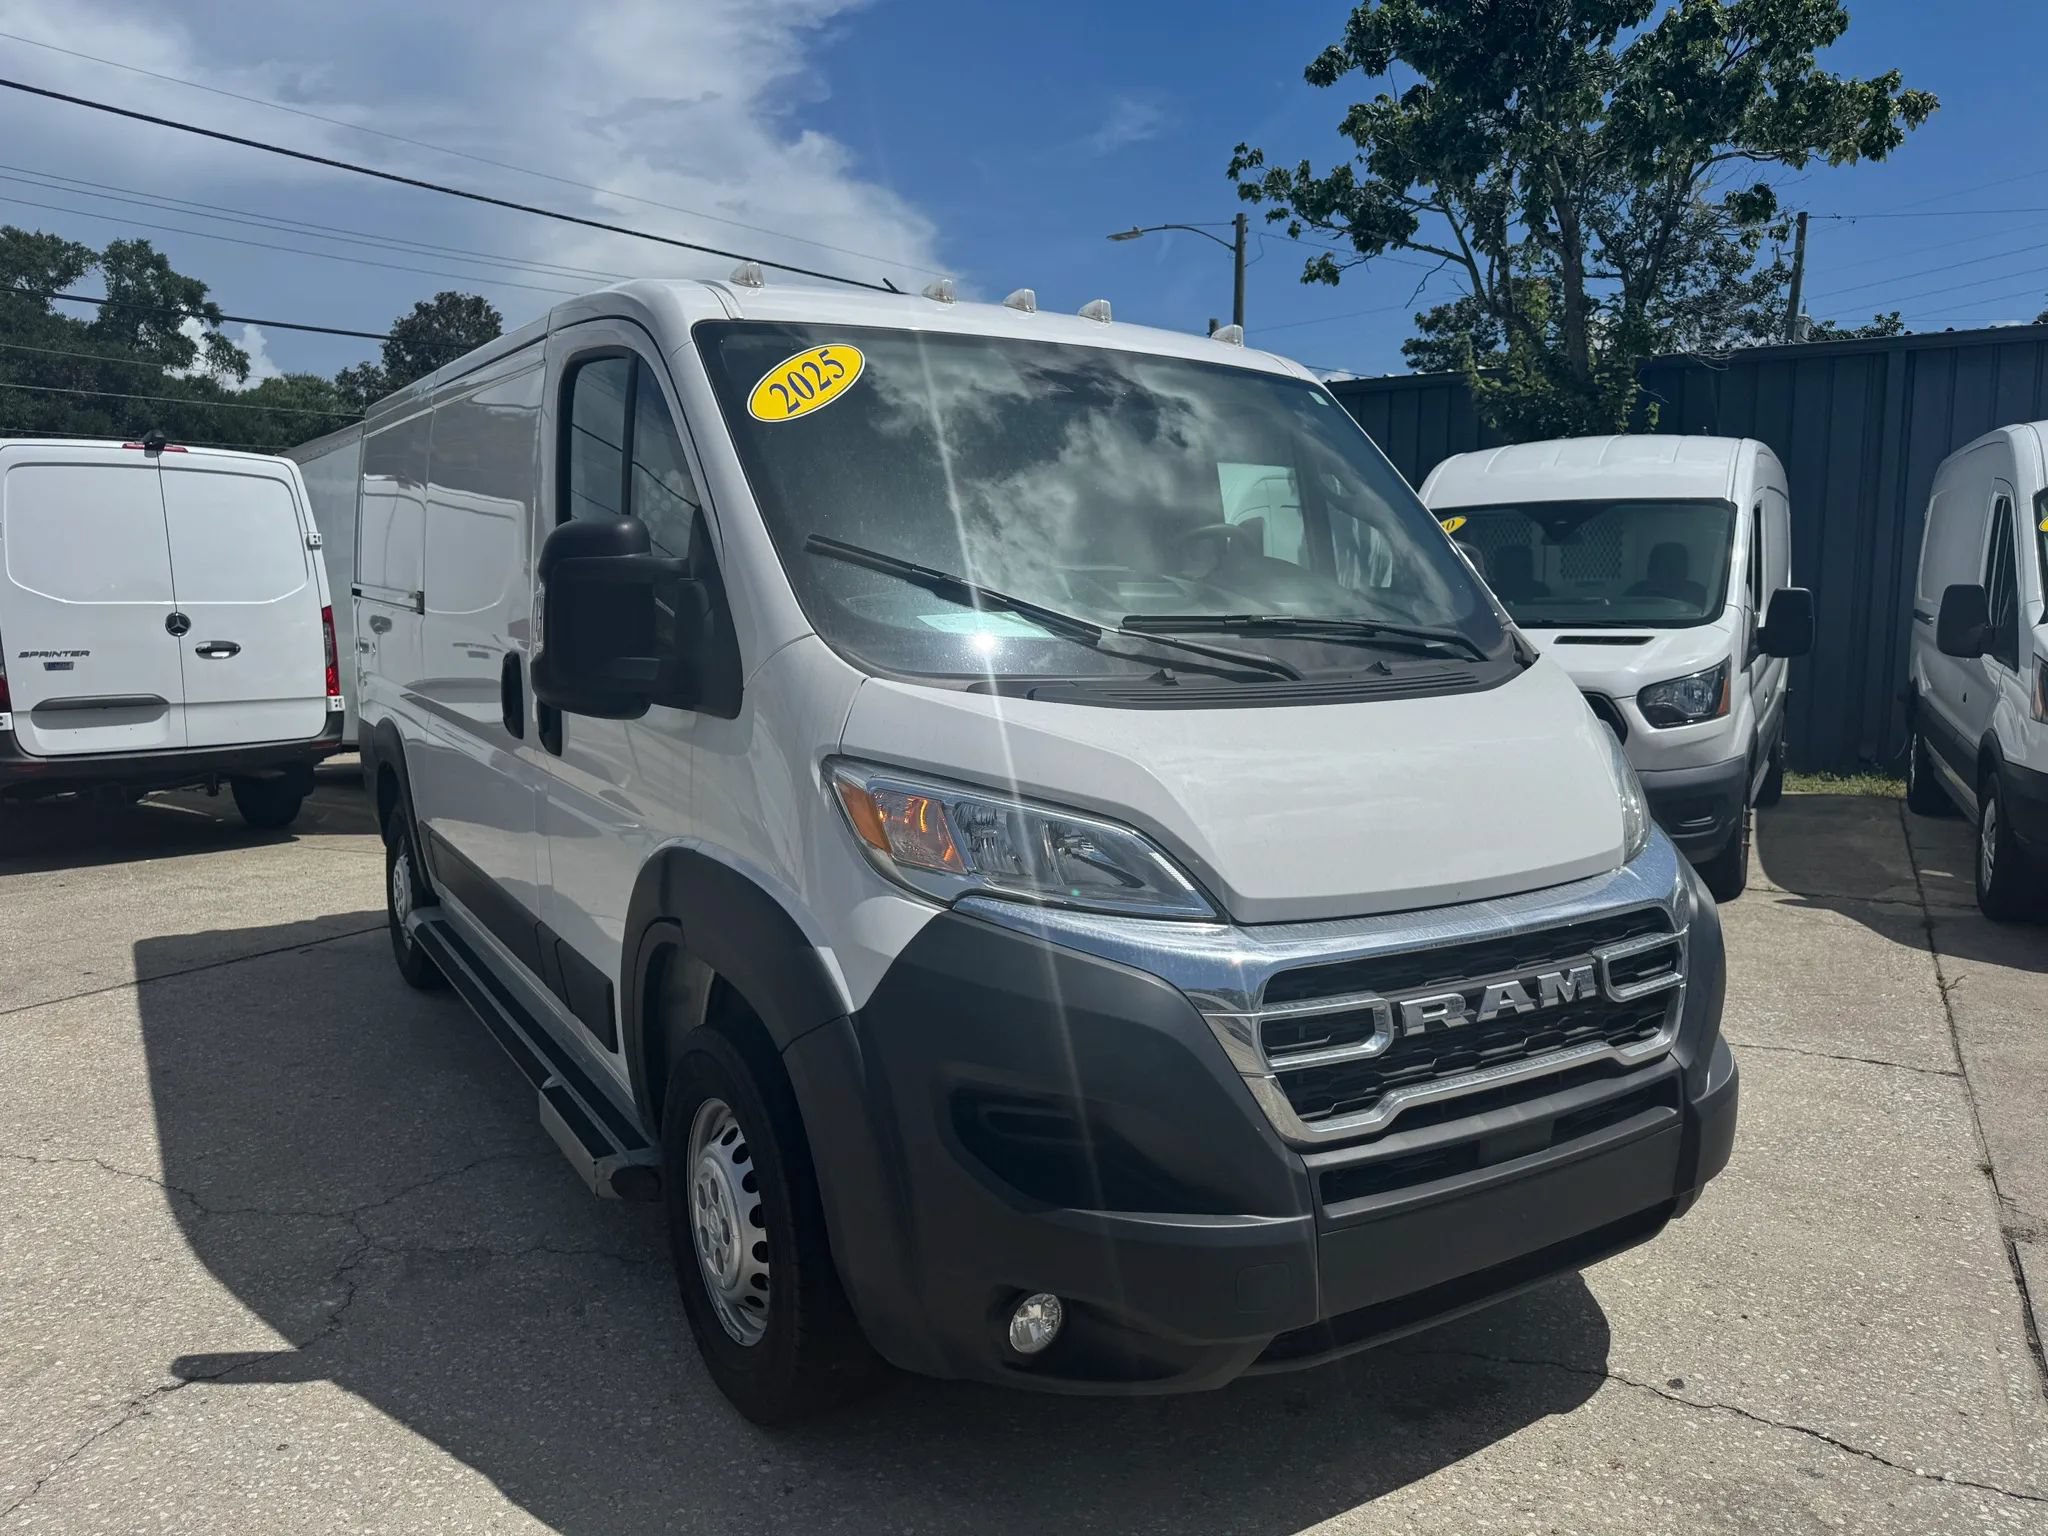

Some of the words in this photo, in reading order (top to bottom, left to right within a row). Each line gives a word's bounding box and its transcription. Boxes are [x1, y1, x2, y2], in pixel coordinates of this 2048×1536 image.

[769, 349, 845, 414] 2025
[18, 650, 91, 659] SPRINTER
[1400, 965, 1597, 1037] RAM
